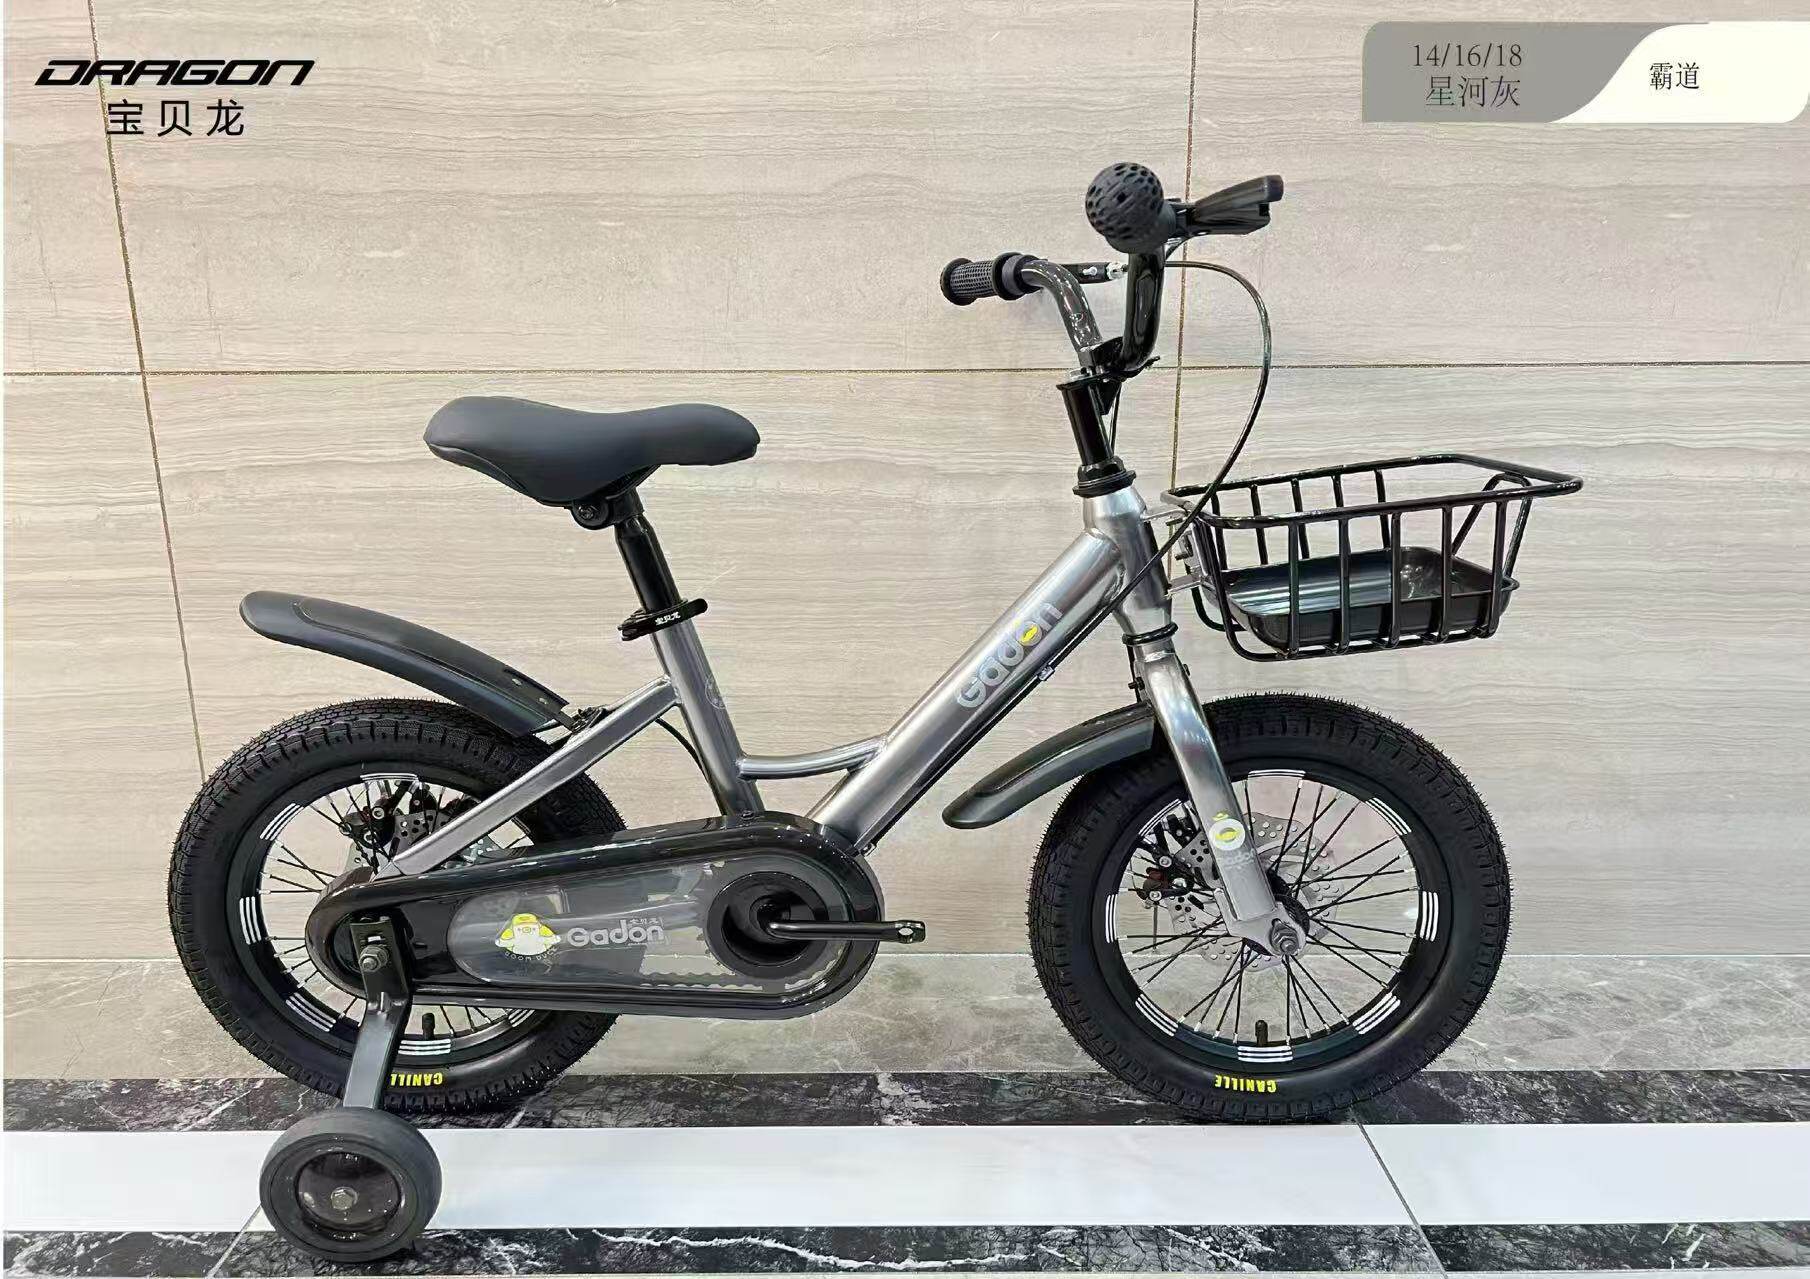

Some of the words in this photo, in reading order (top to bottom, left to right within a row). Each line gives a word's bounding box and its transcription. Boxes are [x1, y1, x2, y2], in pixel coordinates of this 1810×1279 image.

[567, 919, 665, 947] Gadon
[390, 1072, 443, 1087] CANILL
[1215, 1074, 1278, 1093] CANILLE
